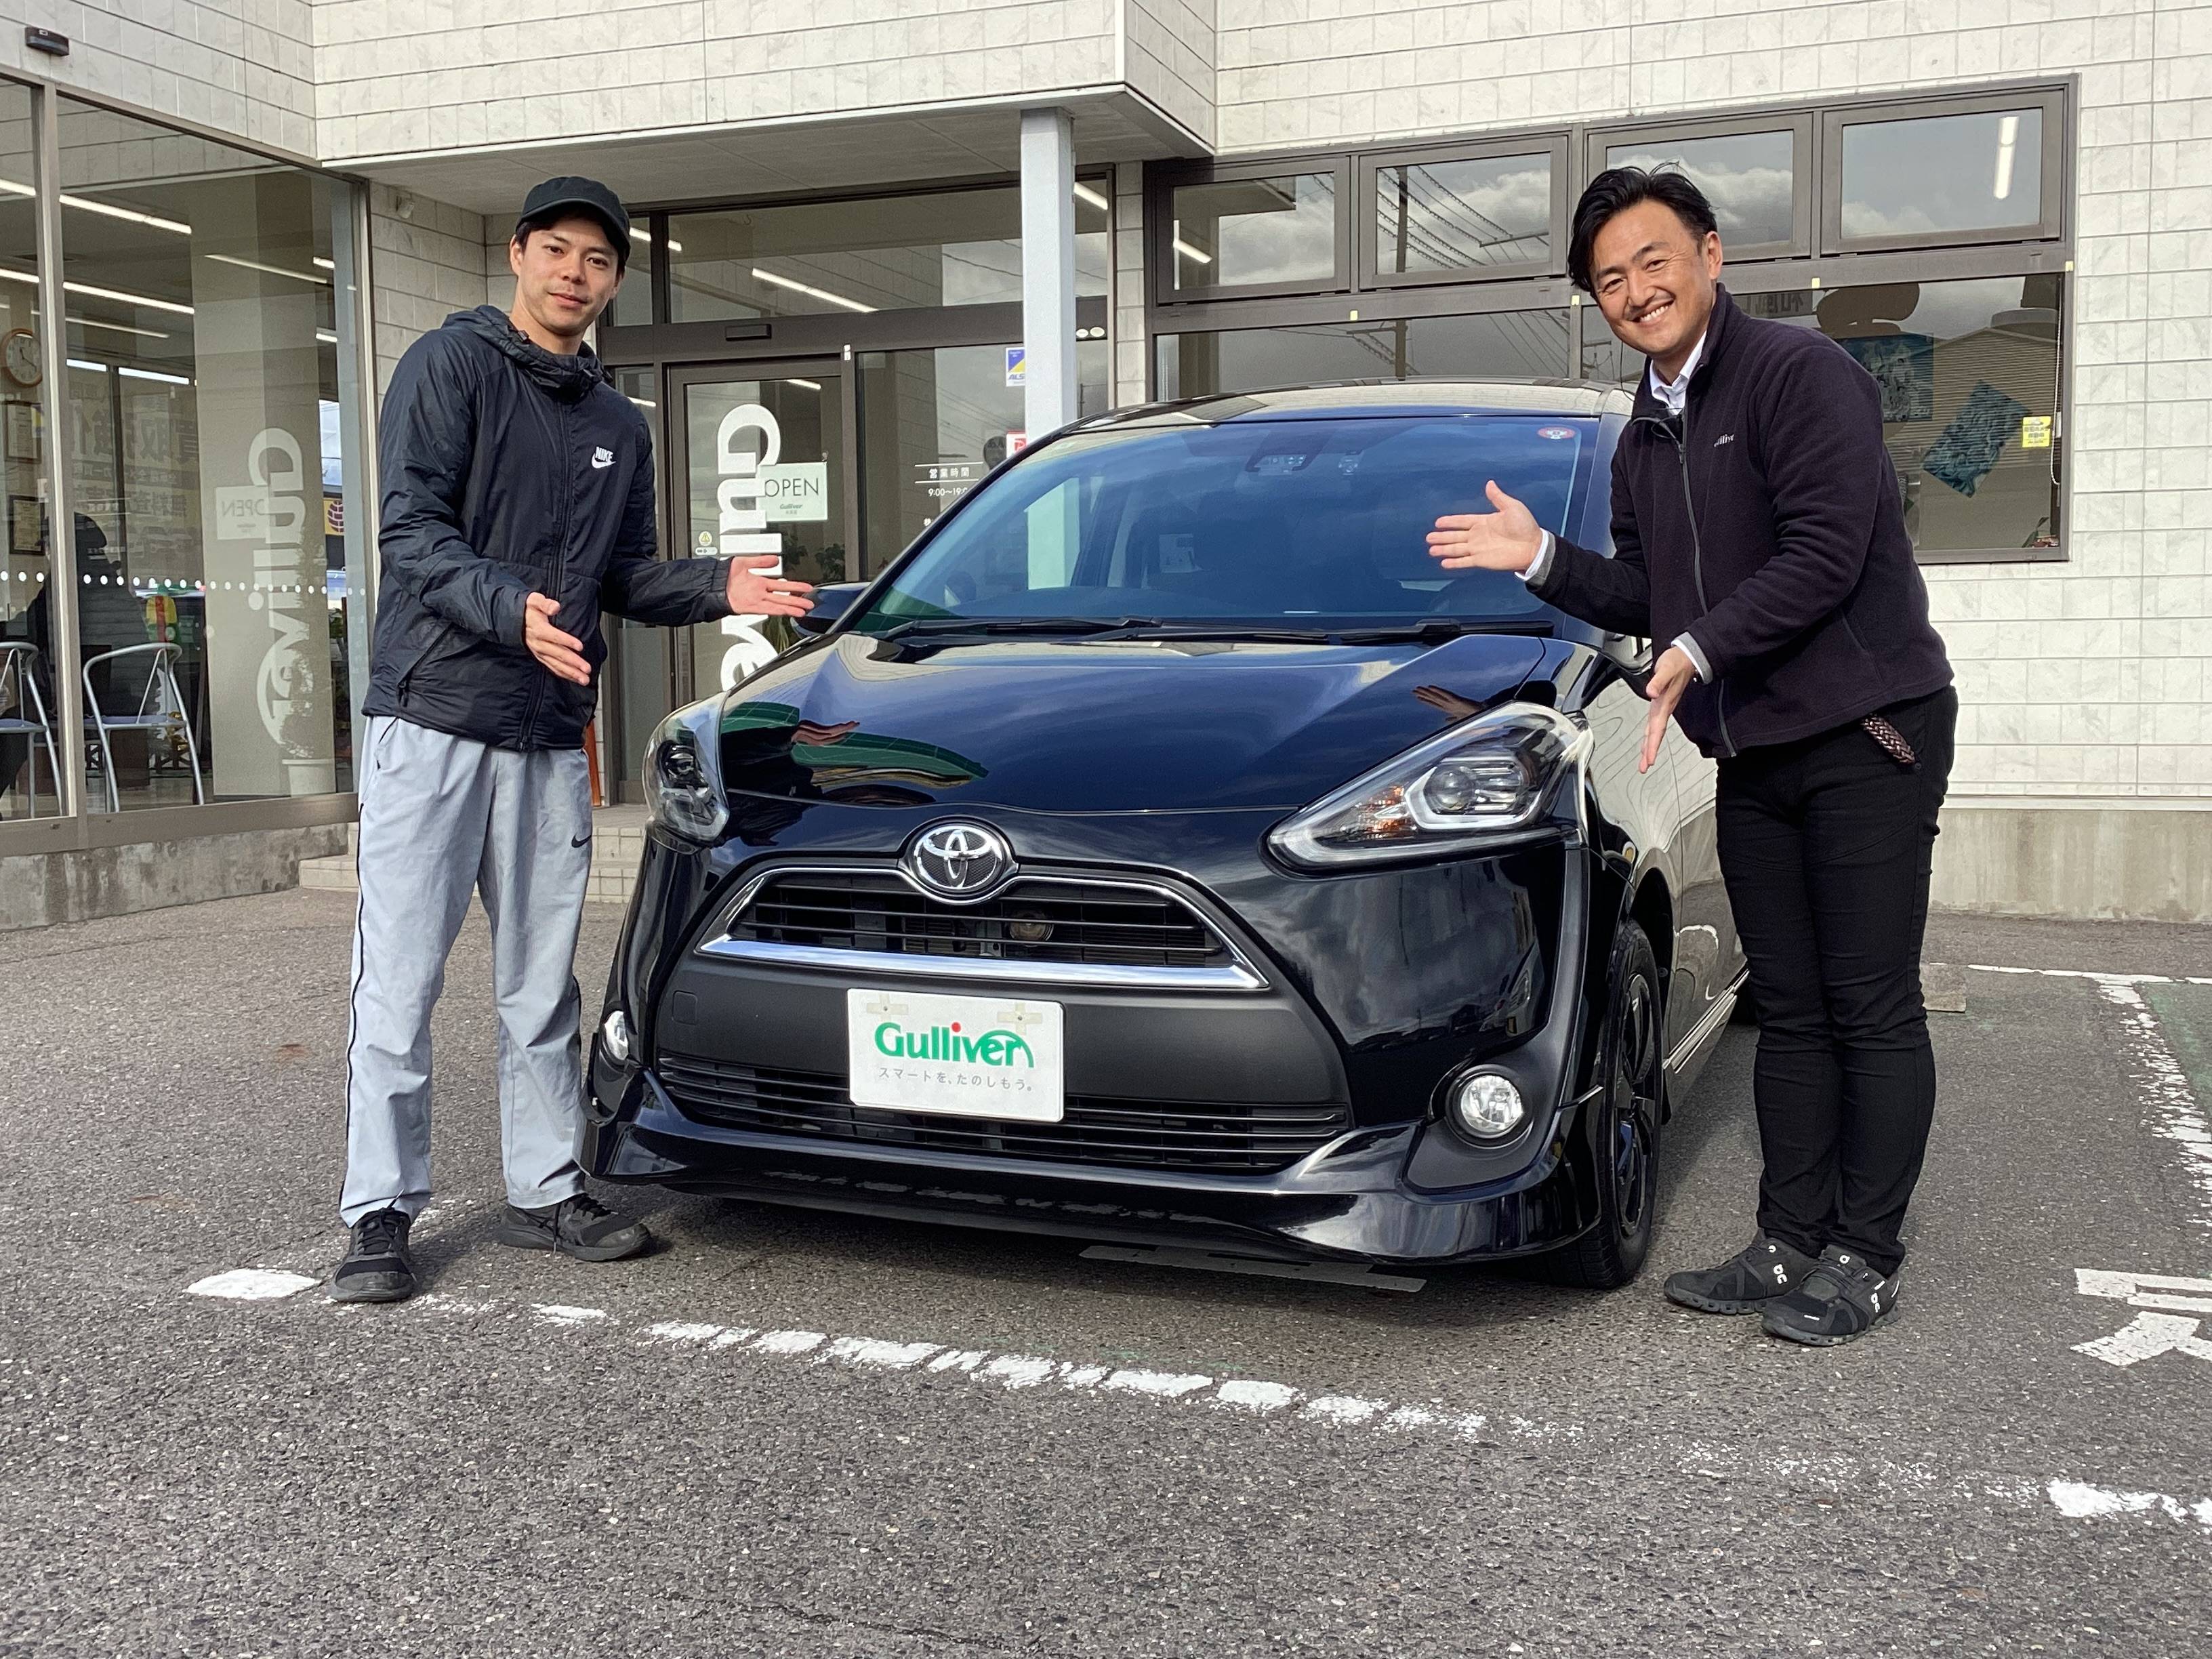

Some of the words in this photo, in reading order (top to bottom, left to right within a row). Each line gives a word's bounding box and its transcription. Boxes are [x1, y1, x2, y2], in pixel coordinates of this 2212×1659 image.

[929, 467, 970, 478] 営業時間
[764, 478, 819, 497] OPEN
[874, 1022, 1034, 1068] Gulliver
[879, 1067, 1032, 1091] スマートを、たのしもう。
